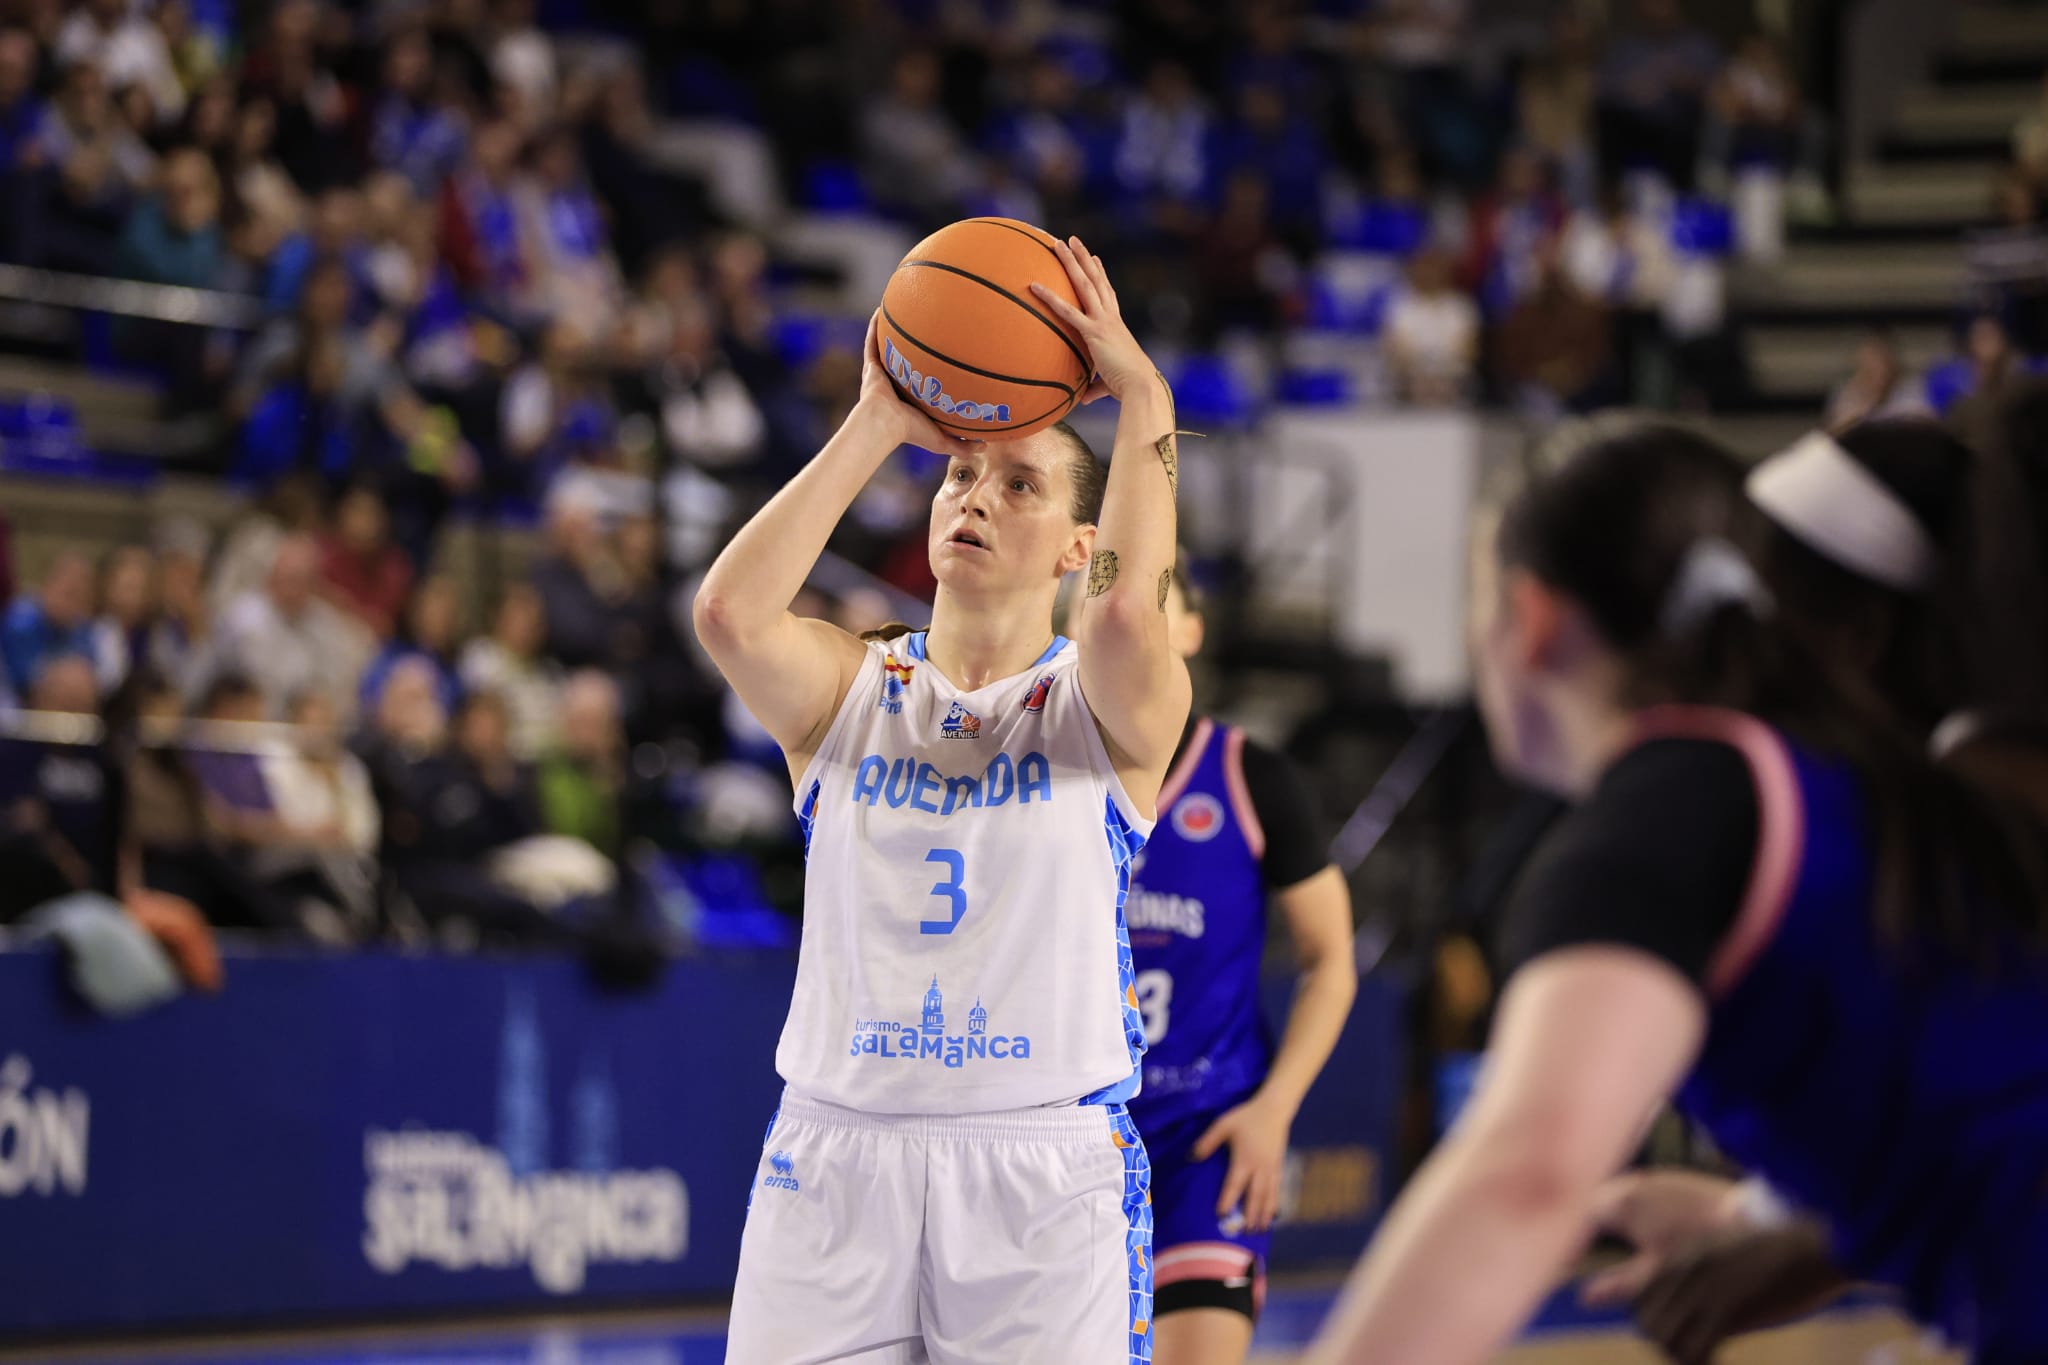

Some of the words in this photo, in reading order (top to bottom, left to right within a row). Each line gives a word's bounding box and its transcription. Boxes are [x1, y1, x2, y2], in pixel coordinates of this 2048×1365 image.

[885, 336, 1011, 422] Wilson
[941, 730, 980, 740] AVENIDA
[919, 848, 968, 935] 3
[855, 1017, 901, 1033] turismo
